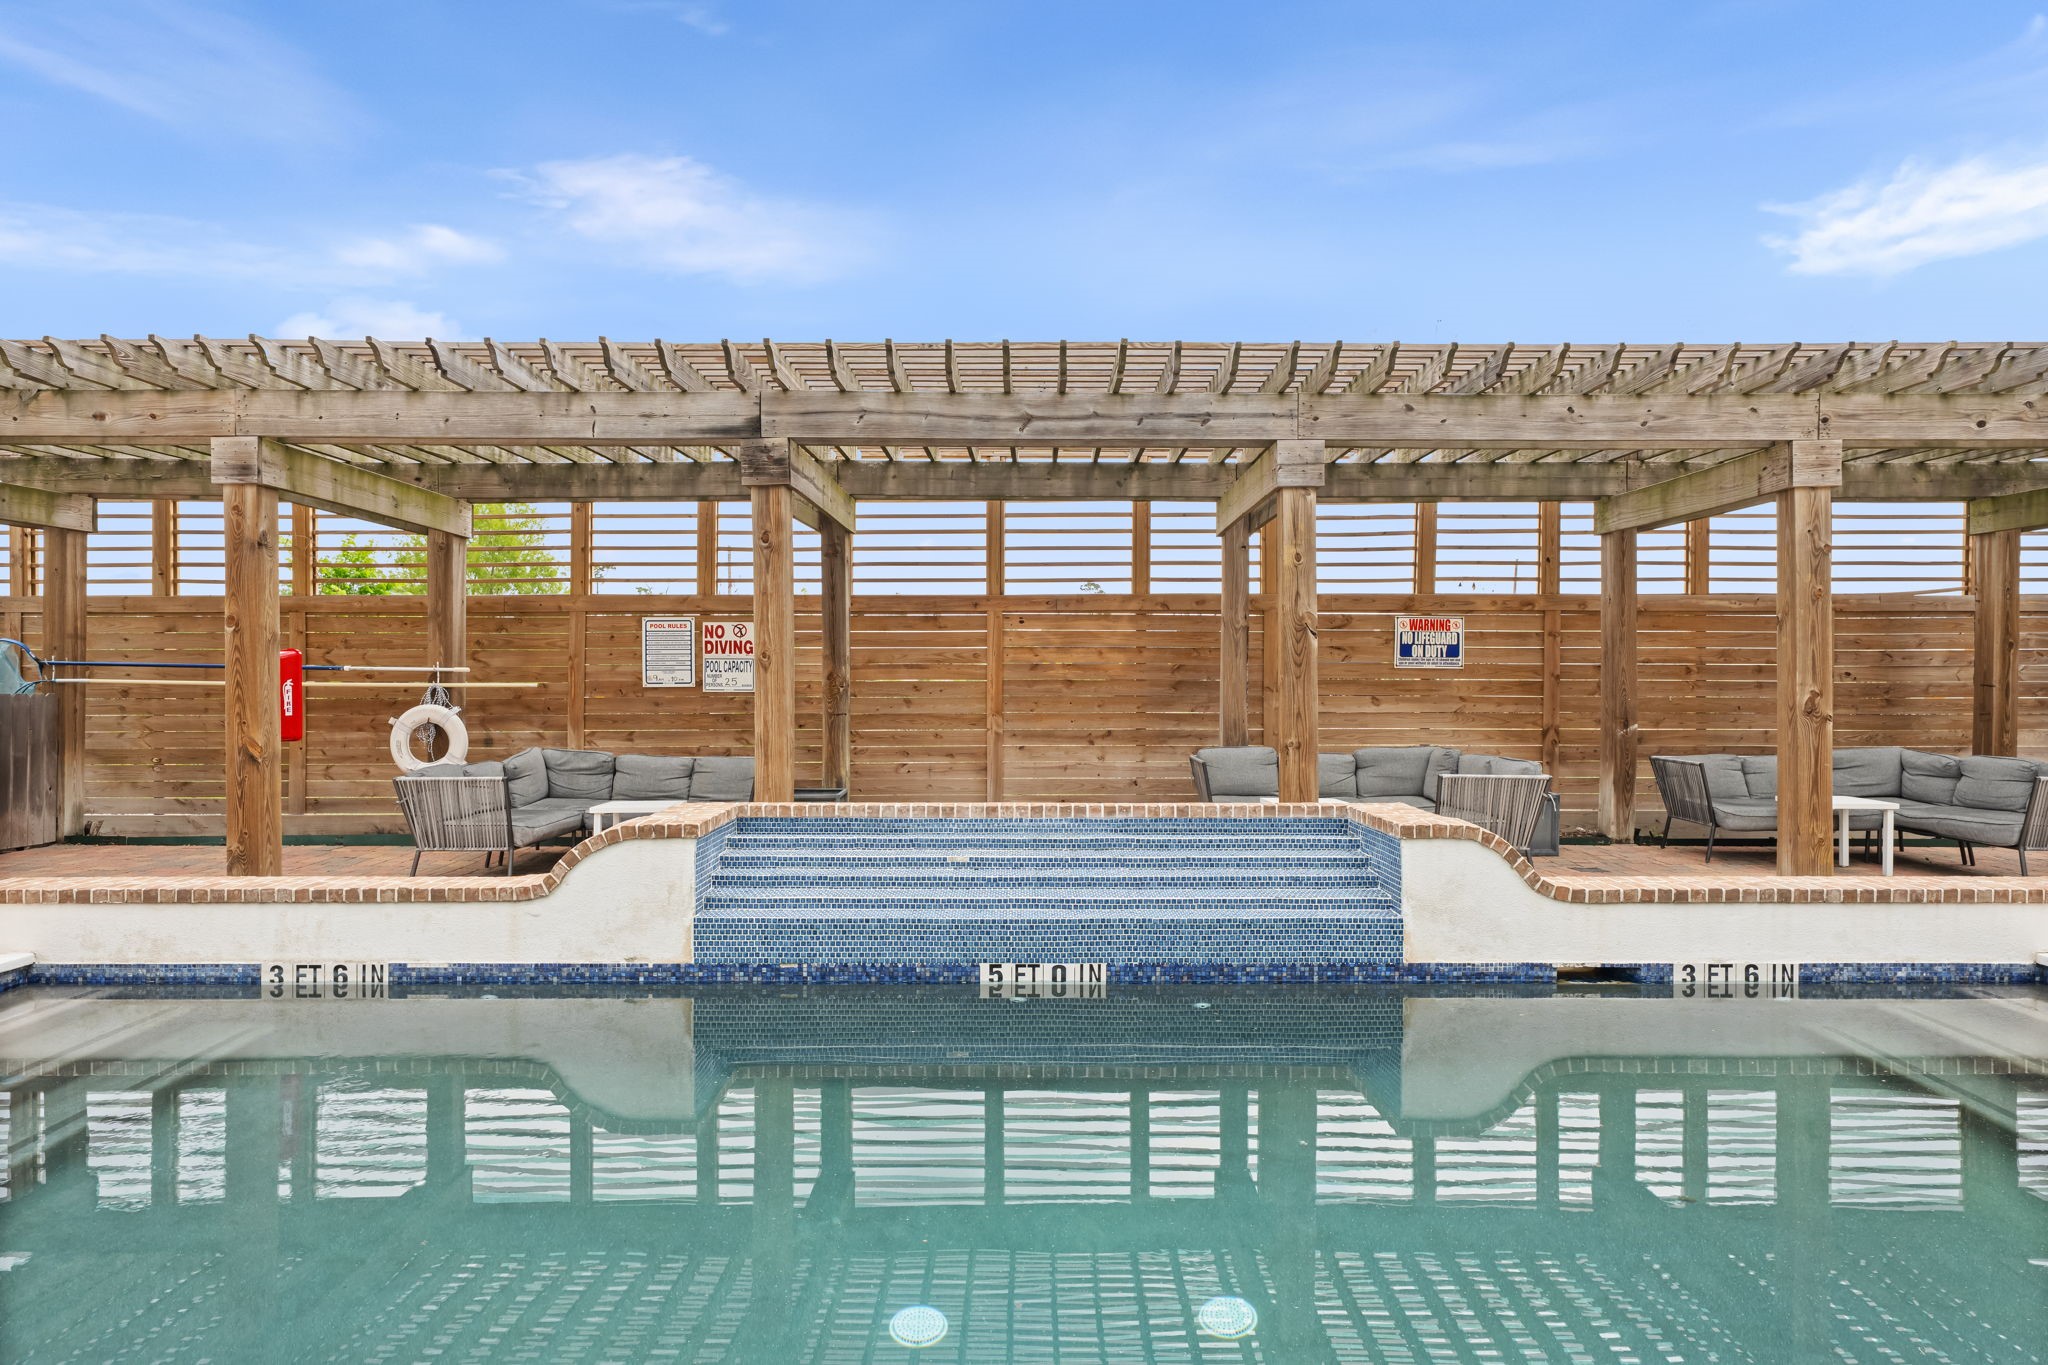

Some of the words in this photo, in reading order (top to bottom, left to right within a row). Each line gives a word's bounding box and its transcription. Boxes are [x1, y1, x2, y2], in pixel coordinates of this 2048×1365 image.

[704, 624, 725, 639] NO
[1409, 618, 1451, 632] WARNING
[1401, 631, 1413, 645] NO
[1414, 631, 1458, 645] LIFEGUARD
[704, 640, 754, 655] DIVING
[1411, 644, 1424, 658] ON
[1425, 644, 1448, 658] DUTY
[705, 660, 722, 673] POOL
[723, 660, 753, 673] CAPACITY
[724, 677, 738, 686] 25
[269, 964, 285, 983] 3
[295, 964, 322, 983] FT
[333, 964, 349, 983] 6
[362, 964, 384, 983] IN
[988, 963, 1004, 983] 5
[1015, 963, 1041, 983] FT
[1051, 963, 1067, 983] 0
[1080, 963, 1102, 983] IN
[1681, 963, 1697, 983] 3
[1707, 963, 1734, 983] FT
[1744, 963, 1760, 983] 6
[1772, 963, 1795, 983] IN
